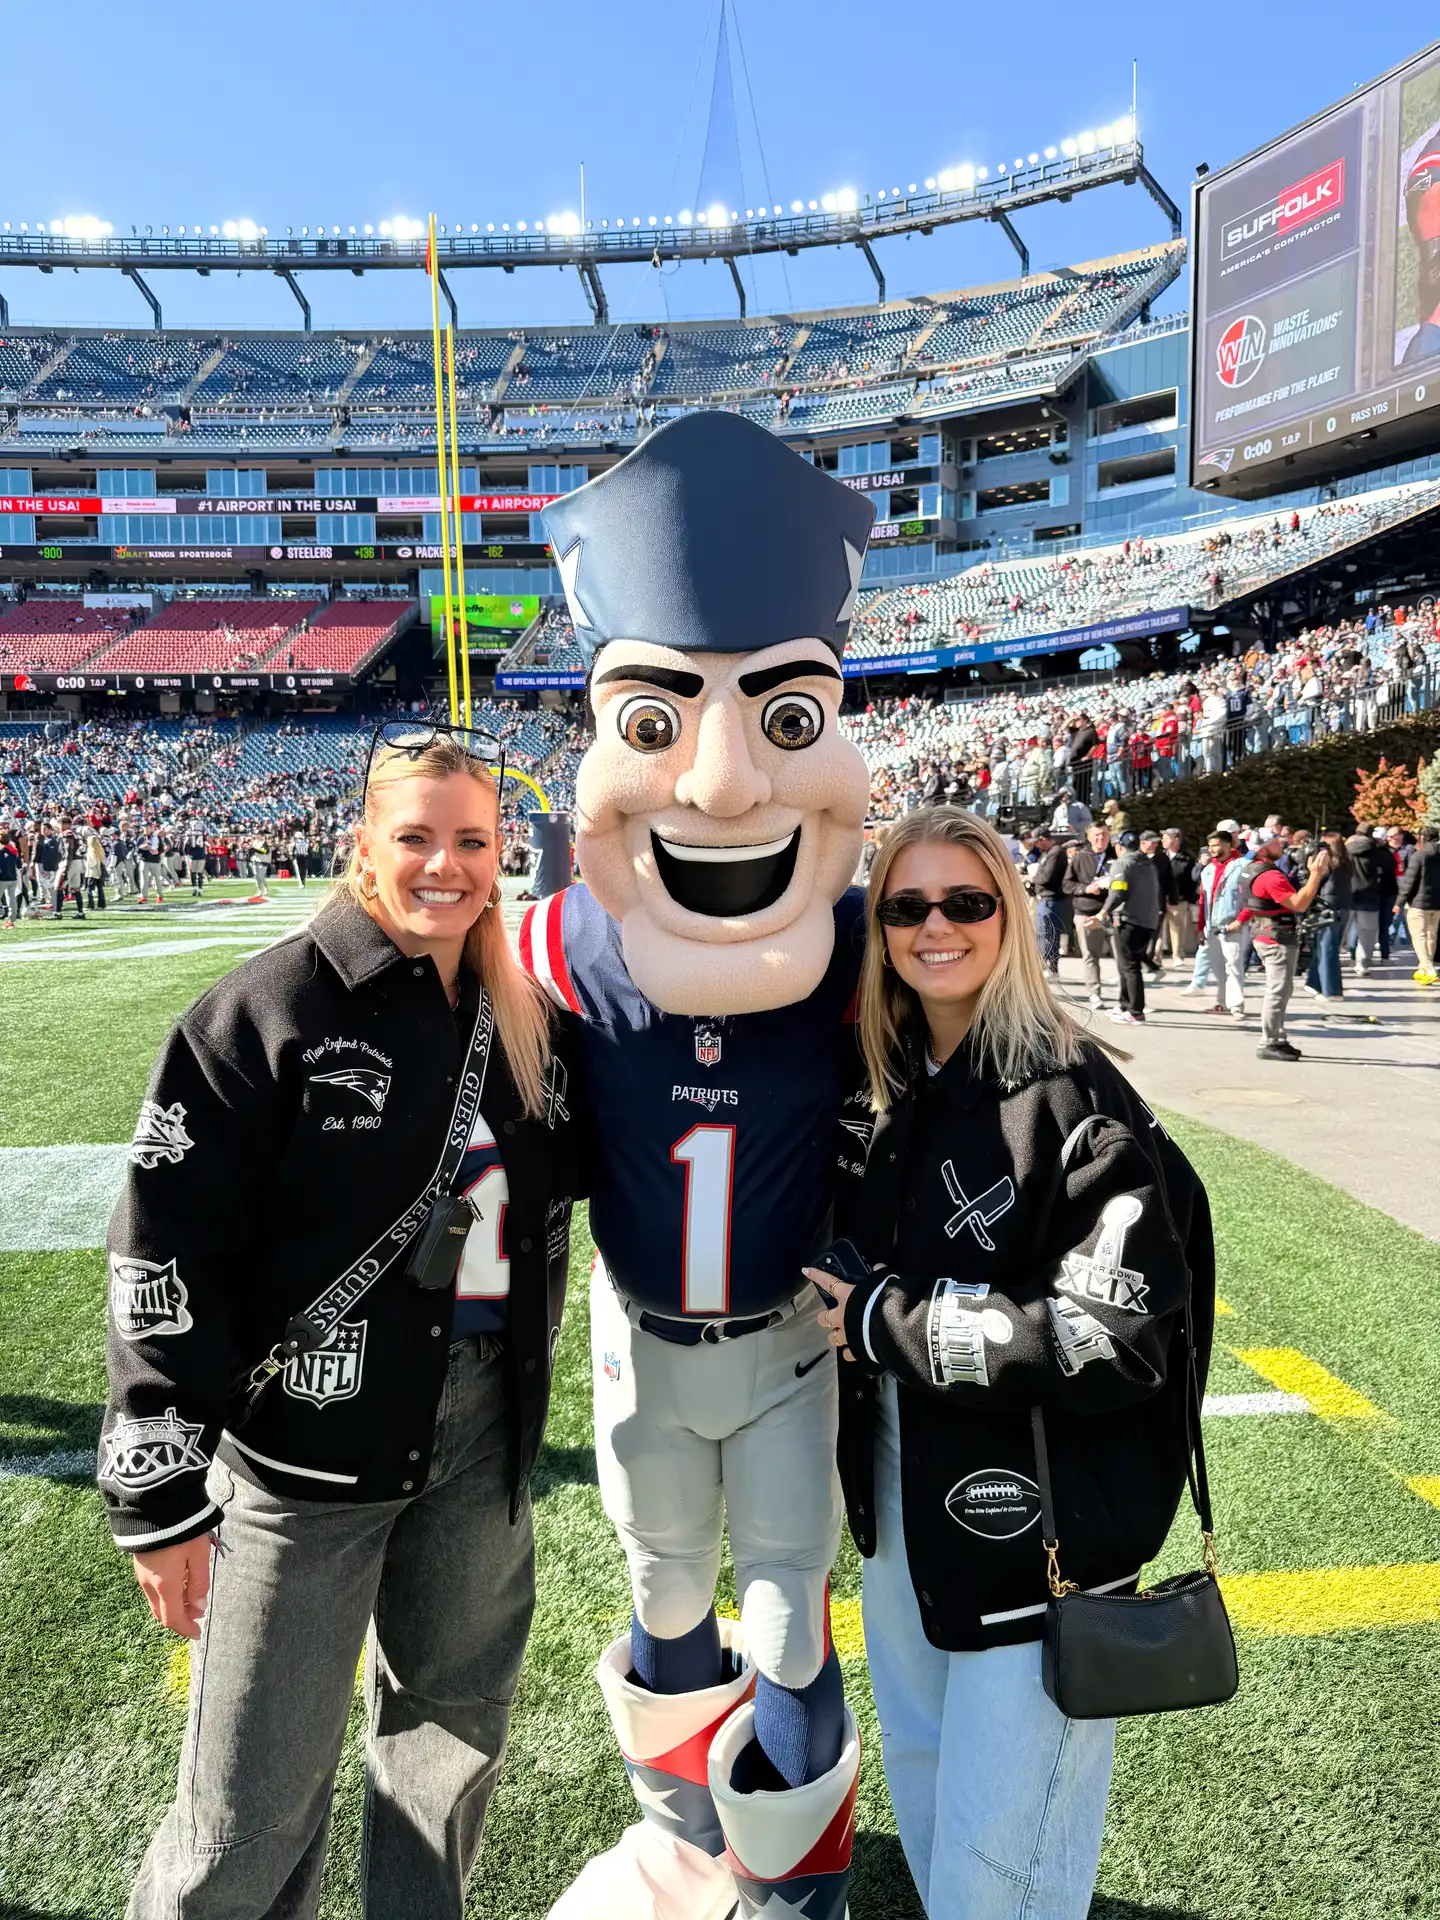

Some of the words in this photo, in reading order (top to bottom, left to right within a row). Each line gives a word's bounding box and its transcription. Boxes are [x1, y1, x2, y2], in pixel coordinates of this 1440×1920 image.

[1227, 178, 1333, 247] SUFFOLK
[1220, 247, 1271, 277] AMERICA'S
[1273, 212, 1341, 251] CONTRACTOR
[1273, 309, 1310, 337] WASTE
[1221, 330, 1262, 372] WIN
[1214, 391, 1273, 423] PERFORMANCE
[1273, 386, 1290, 402] FOR
[1290, 379, 1307, 395] THE
[1306, 366, 1340, 389] PLANET
[1243, 439, 1272, 461] 0:00
[1326, 417, 1336, 433] 0
[1351, 409, 1371, 423] PASS
[1372, 401, 1388, 416] YDS
[1415, 385, 1426, 401] 0
[872, 472, 905, 487] USA!
[17, 499, 44, 511] THE
[48, 500, 80, 511] USA!
[198, 501, 213, 512] #1
[216, 501, 274, 512] AIRPORT
[278, 500, 292, 511] IN
[295, 500, 321, 511] THE
[325, 500, 357, 511] USA!
[474, 498, 488, 510] #1
[491, 497, 549, 509] AIRPORT
[38, 547, 63, 559] +900
[117, 549, 175, 559] DRAFTKINGS
[179, 550, 233, 559] SPORTSBOOK
[287, 547, 332, 559] STEELERS
[415, 546, 457, 558] PACKES
[1103, 624, 1126, 637] ENGLAND
[1126, 619, 1150, 632] PATRIOTS
[1150, 613, 1180, 627] TAILGATING
[57, 677, 86, 689] 0:00
[135, 677, 144, 689] 0
[154, 678, 169, 687] PASS
[170, 678, 182, 687] YDS
[213, 676, 222, 688] 0
[247, 678, 260, 686] YDS
[286, 676, 296, 688] 0
[191, 835, 204, 848] 14
[474, 987, 493, 1057] GUESS
[302, 1045, 326, 1064] New
[324, 1036, 358, 1054] England
[359, 1041, 393, 1068] Patriots
[699, 1048, 718, 1061] NFL
[671, 1084, 739, 1105] PATRIOTS
[322, 1116, 345, 1131] Est.
[351, 1115, 382, 1129] 1960
[450, 1071, 480, 1150] GUESS
[390, 1186, 442, 1246] UESS
[670, 1122, 737, 1314] 1
[449, 1226, 468, 1235] GUESS
[1073, 1258, 1106, 1273] SUPER
[1109, 1268, 1137, 1282] BOWL
[308, 1257, 380, 1331] GUESS
[1056, 1261, 1149, 1311] XLIX
[932, 1295, 943, 1331] SUPER
[932, 1334, 941, 1366] BOWL
[1053, 1340, 1070, 1367] BOWL
[292, 1352, 352, 1396] NFL
[148, 1431, 180, 1443] BOWL
[101, 1433, 204, 1478] XXXIX
